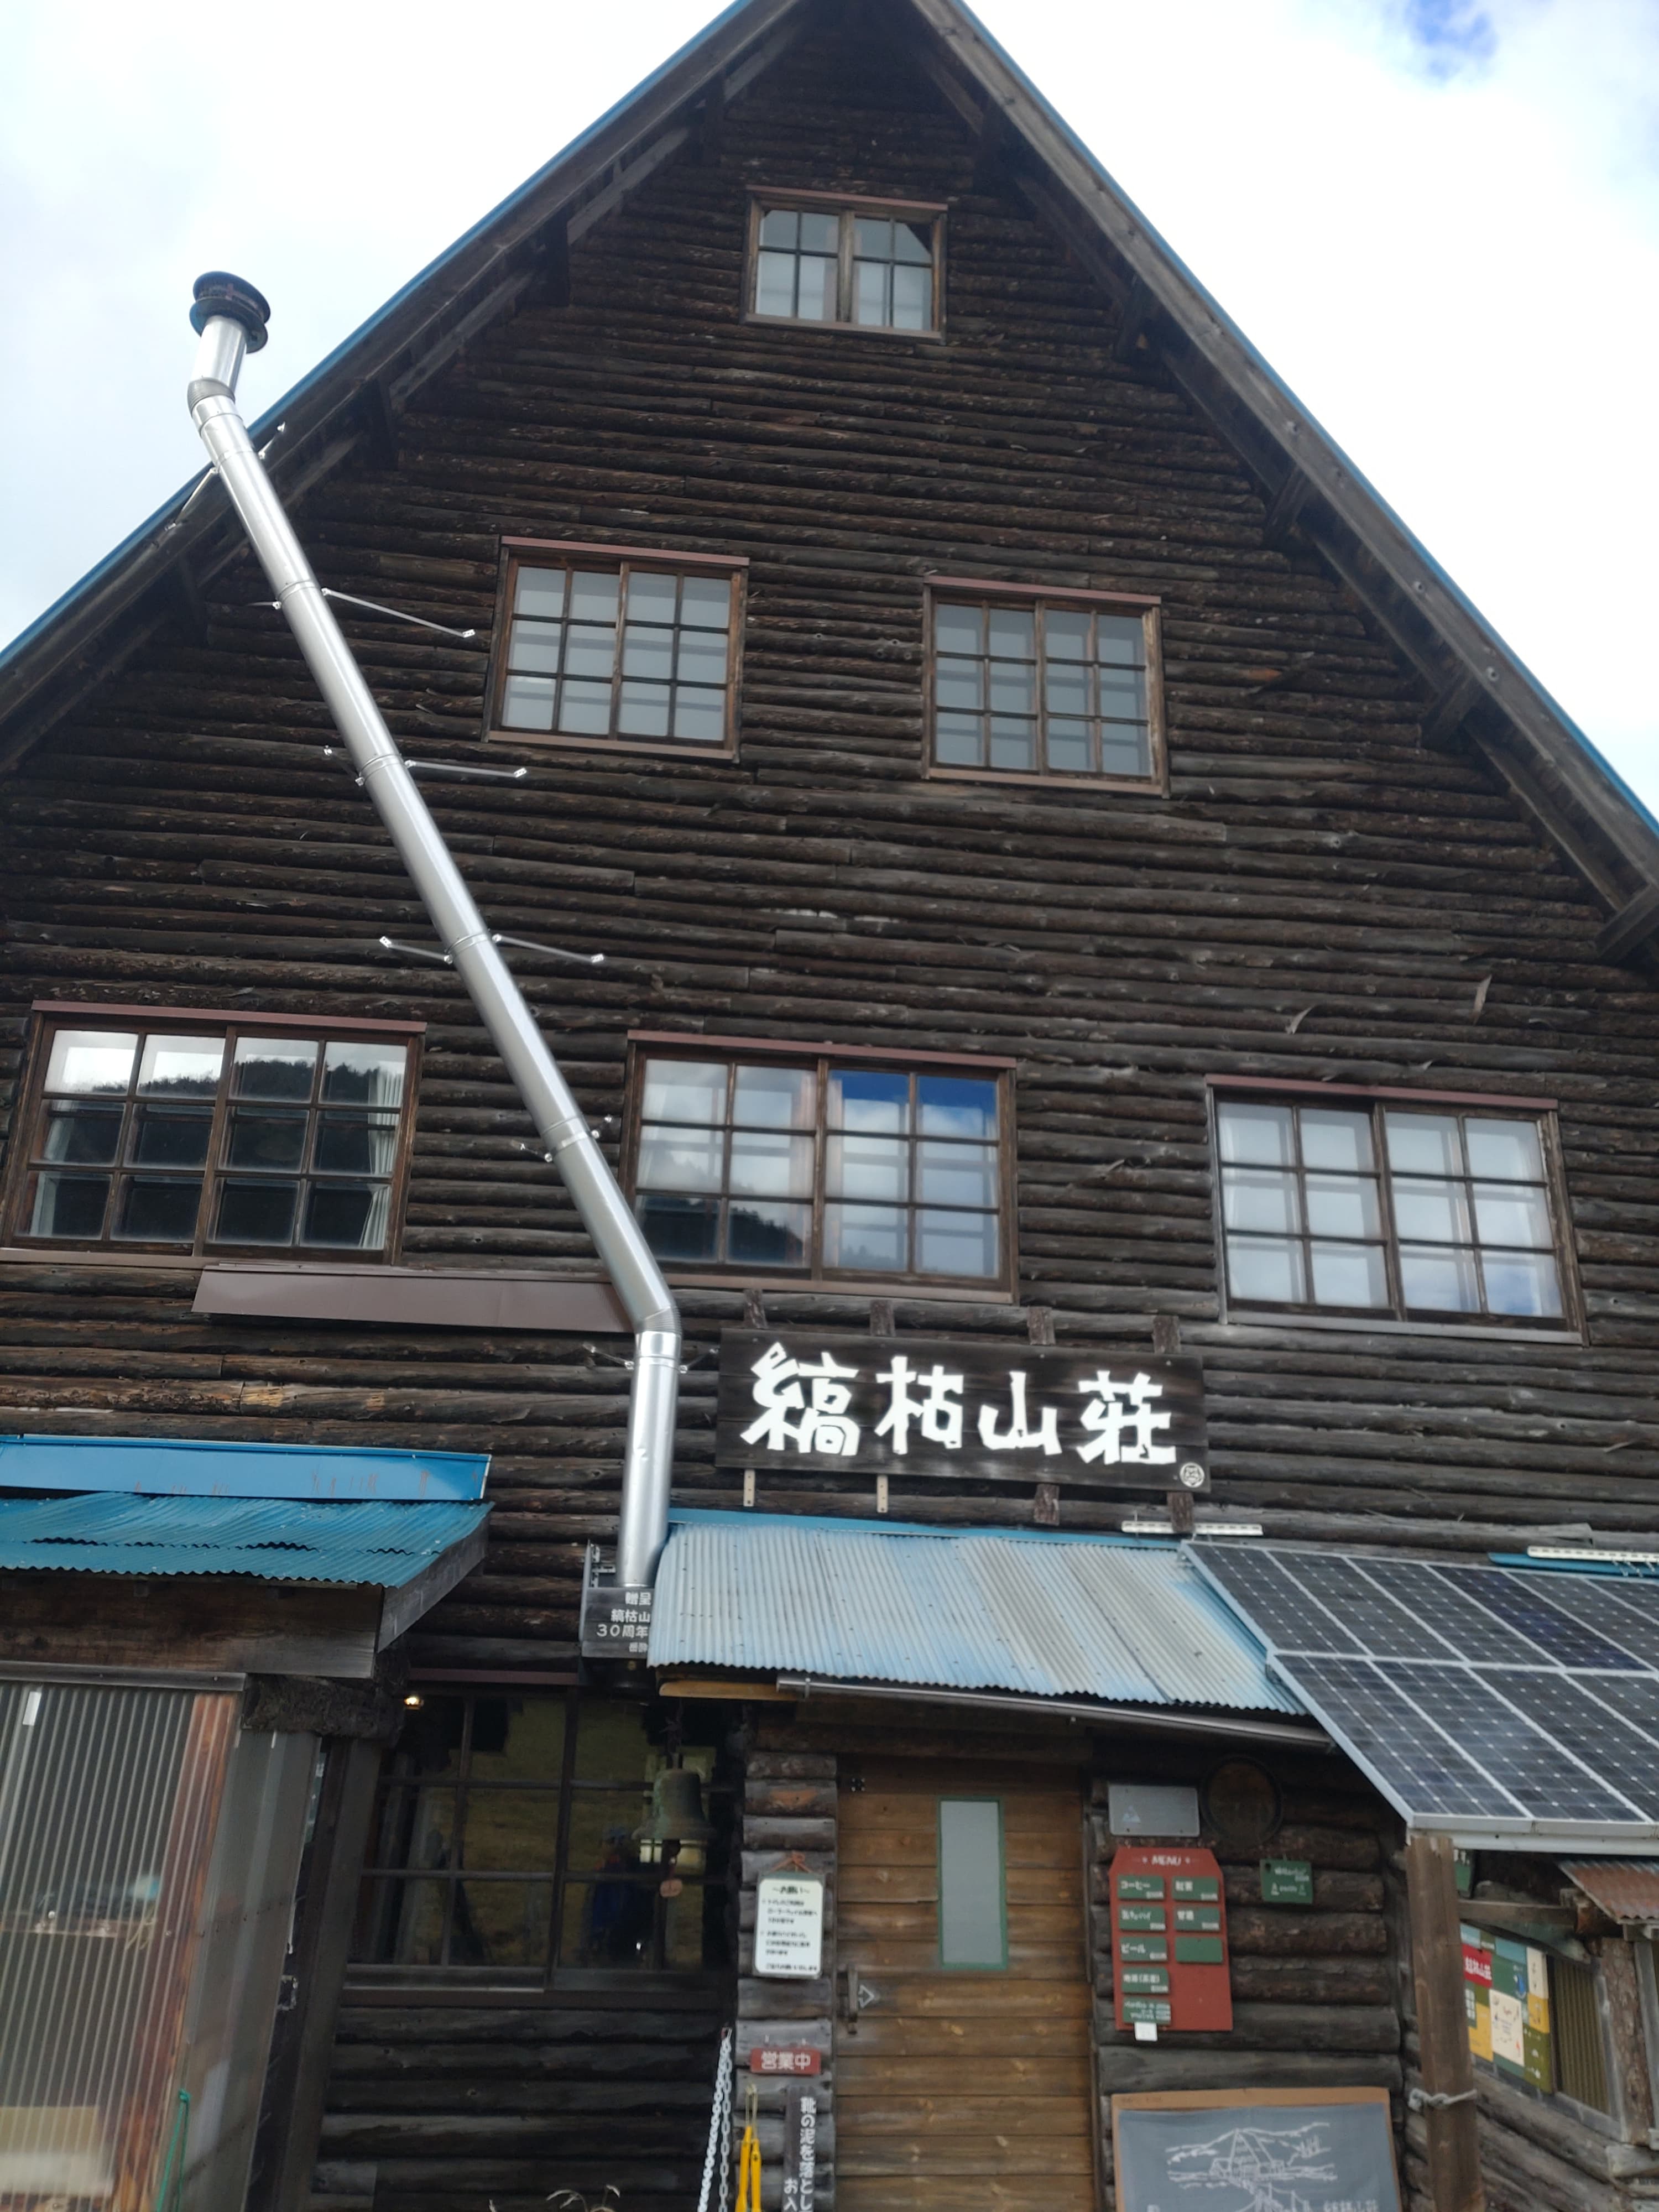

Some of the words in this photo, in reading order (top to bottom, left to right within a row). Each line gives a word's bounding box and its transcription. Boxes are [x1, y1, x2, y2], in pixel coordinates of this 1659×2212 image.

[740, 1342, 1177, 1465] 縞枯山荘
[1151, 1855, 1182, 1866] MENU
[761, 2051, 811, 2070] 営業中
[800, 2097, 816, 2212] 靴の泥を落とし
